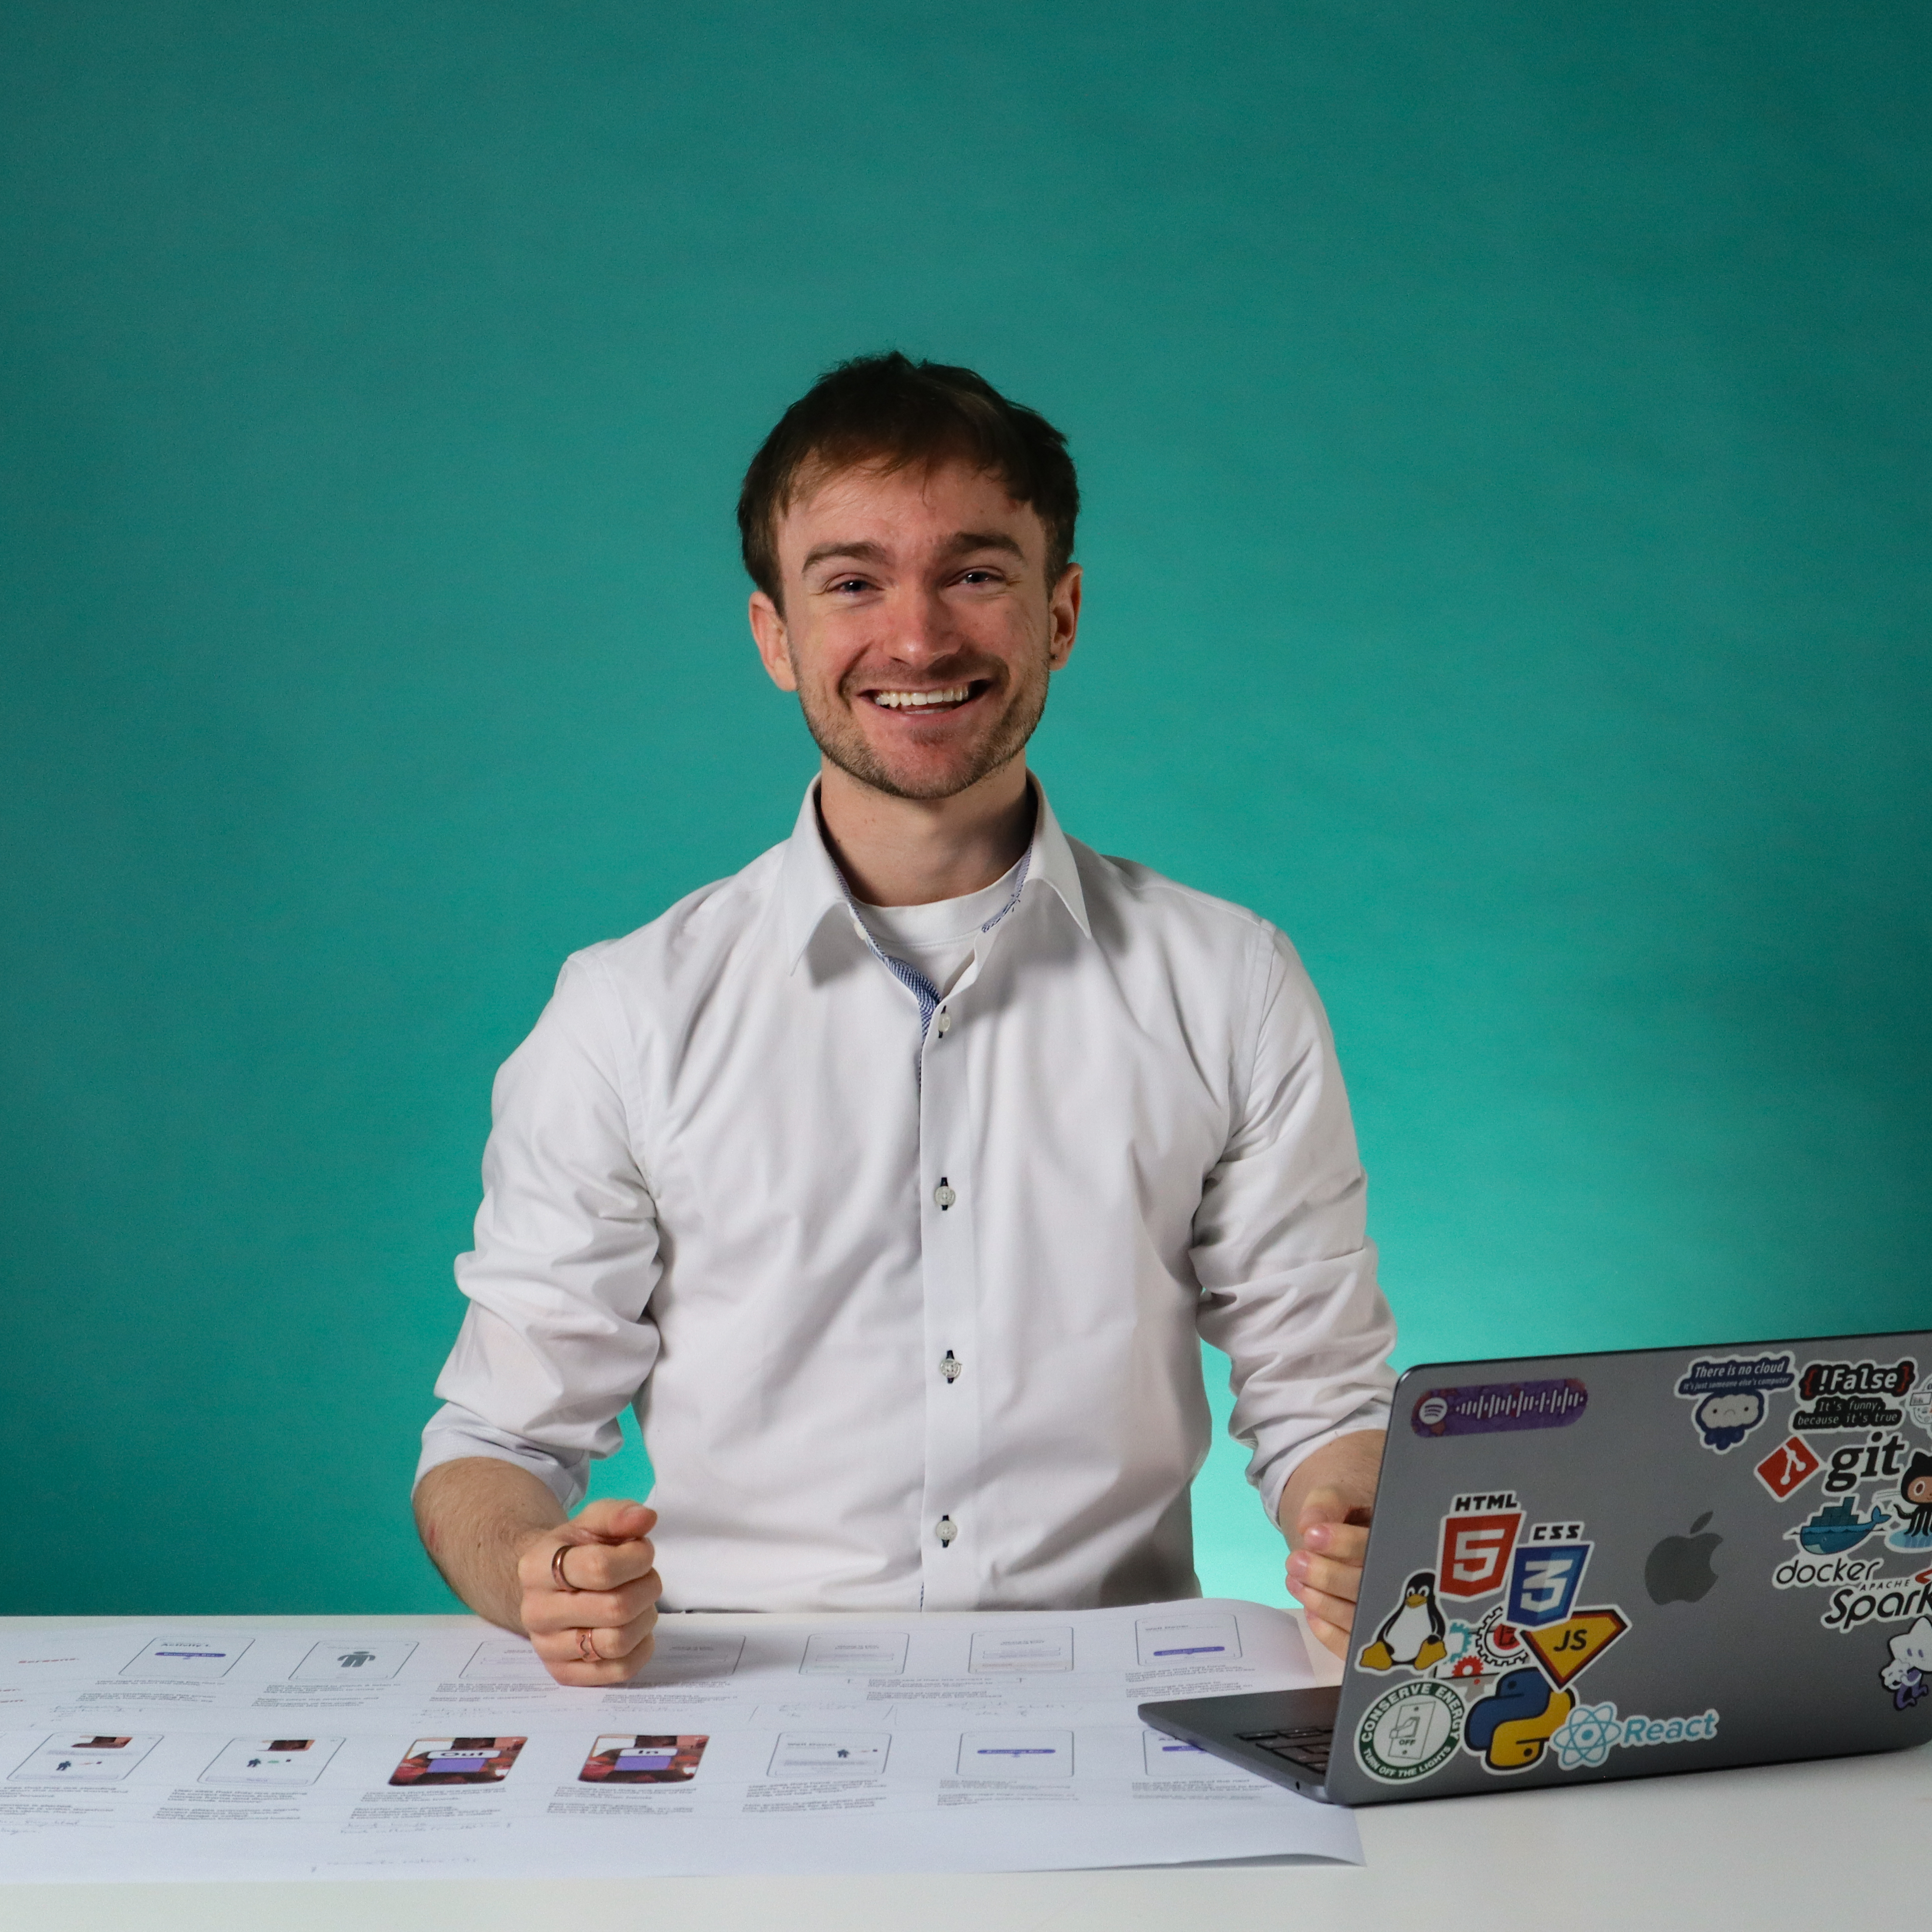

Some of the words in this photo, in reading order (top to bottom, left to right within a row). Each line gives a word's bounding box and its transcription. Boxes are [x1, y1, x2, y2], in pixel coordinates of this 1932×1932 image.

[1695, 1366, 1726, 1378] There
[1727, 1364, 1736, 1376] is
[1738, 1366, 1752, 1375] no
[1754, 1361, 1786, 1374] cloud
[1694, 1382, 1708, 1391] just
[1819, 1401, 1842, 1411] It's
[1850, 1401, 1881, 1411] funny,
[1798, 1416, 1839, 1426] because
[1847, 1413, 1868, 1423] it's
[1875, 1412, 1898, 1422] true
[1825, 1432, 1905, 1492] git
[1455, 1494, 1518, 1512] HTML
[1533, 1525, 1580, 1540] CSS
[1453, 1529, 1505, 1582] 5
[1776, 1558, 1881, 1584] docker
[1520, 1559, 1573, 1612] 3
[1860, 1579, 1911, 1592] APACHE
[1554, 1629, 1587, 1651] JS
[1361, 1683, 1432, 1743] CONSERVE
[1435, 1687, 1463, 1740] ENERGY
[1623, 1713, 1715, 1743] React
[1363, 1748, 1380, 1771] TURN
[1379, 1767, 1397, 1777] OFF
[1398, 1768, 1417, 1777] THE
[1419, 1746, 1451, 1773] LIGHTS
